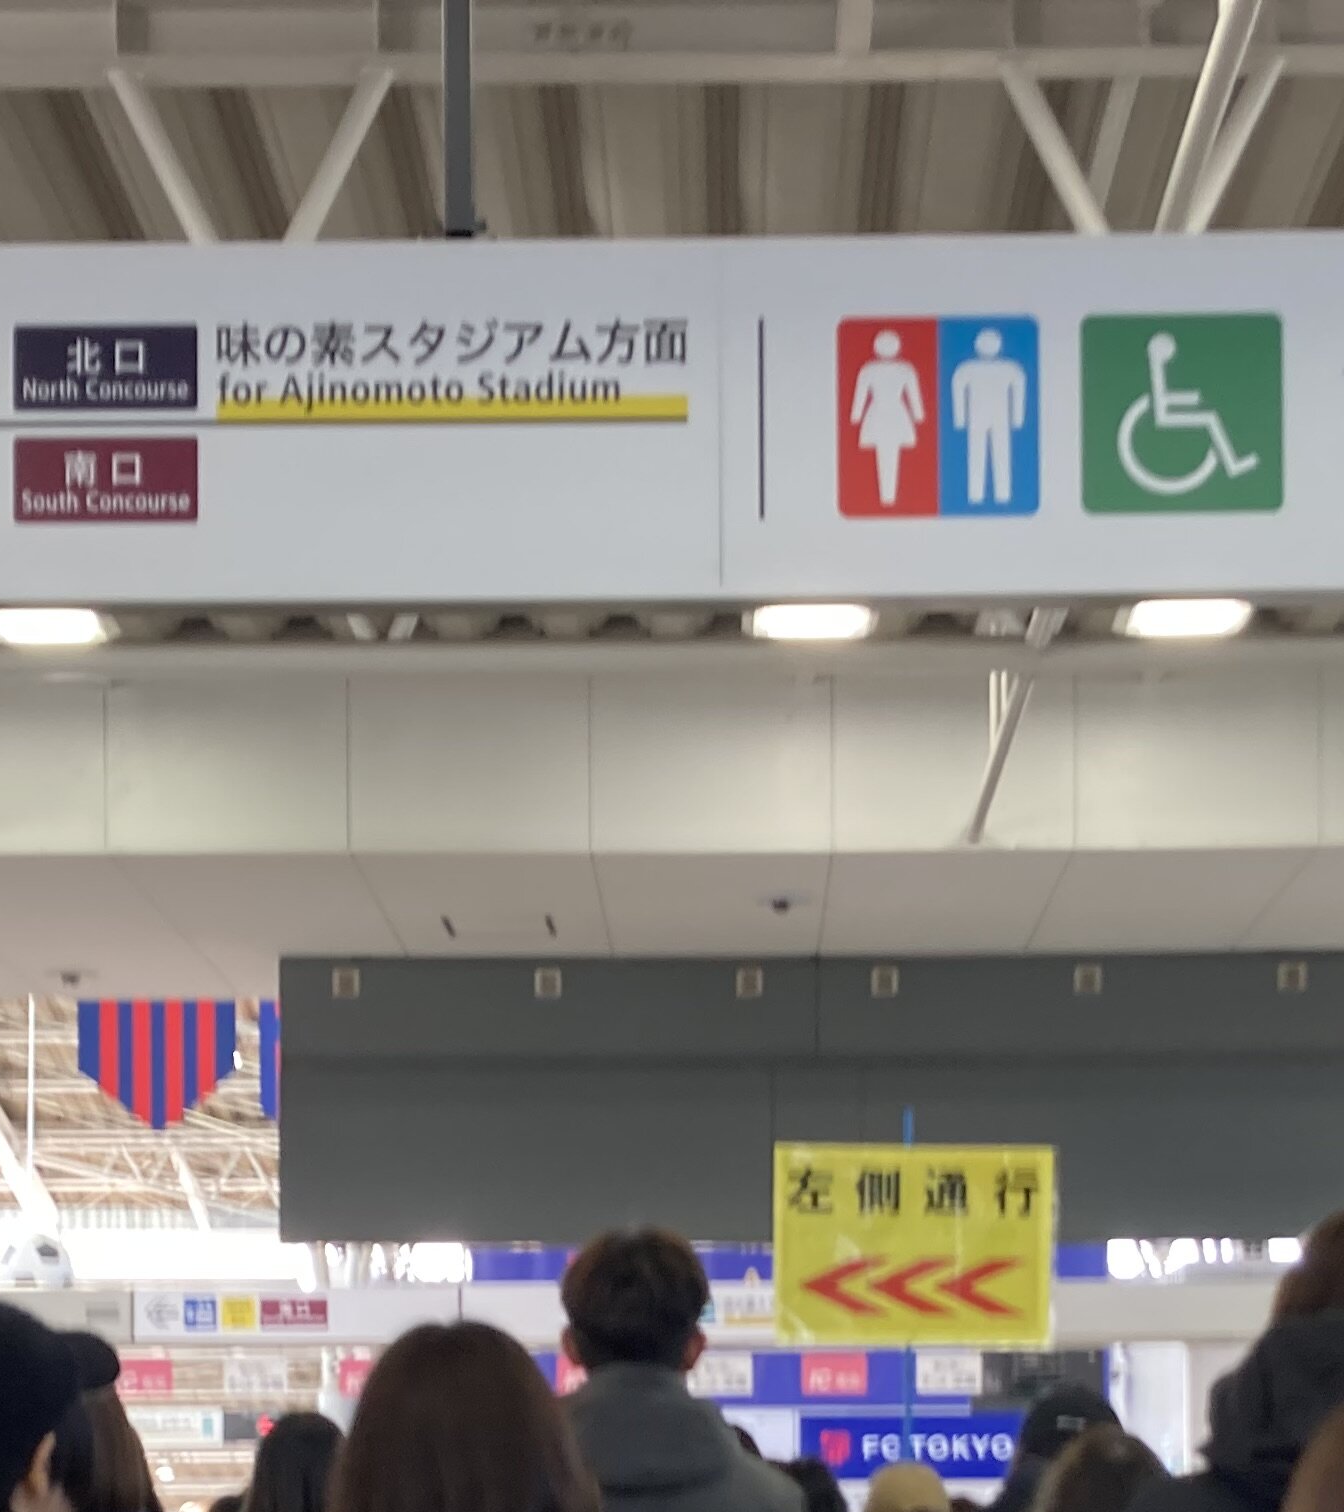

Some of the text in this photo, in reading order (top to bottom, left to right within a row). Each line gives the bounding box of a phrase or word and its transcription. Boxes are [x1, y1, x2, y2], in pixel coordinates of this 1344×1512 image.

[67, 336, 146, 376] 北口
[216, 318, 688, 366] 味の素スタジアム方面
[22, 377, 189, 403] North Concourse
[218, 370, 622, 416] for Ajinomoto Stadium
[64, 449, 142, 489] 南口
[21, 488, 191, 515] South Concourse
[787, 1165, 1038, 1217] 左側通行
[862, 1432, 1016, 1463] FC TOKYO
